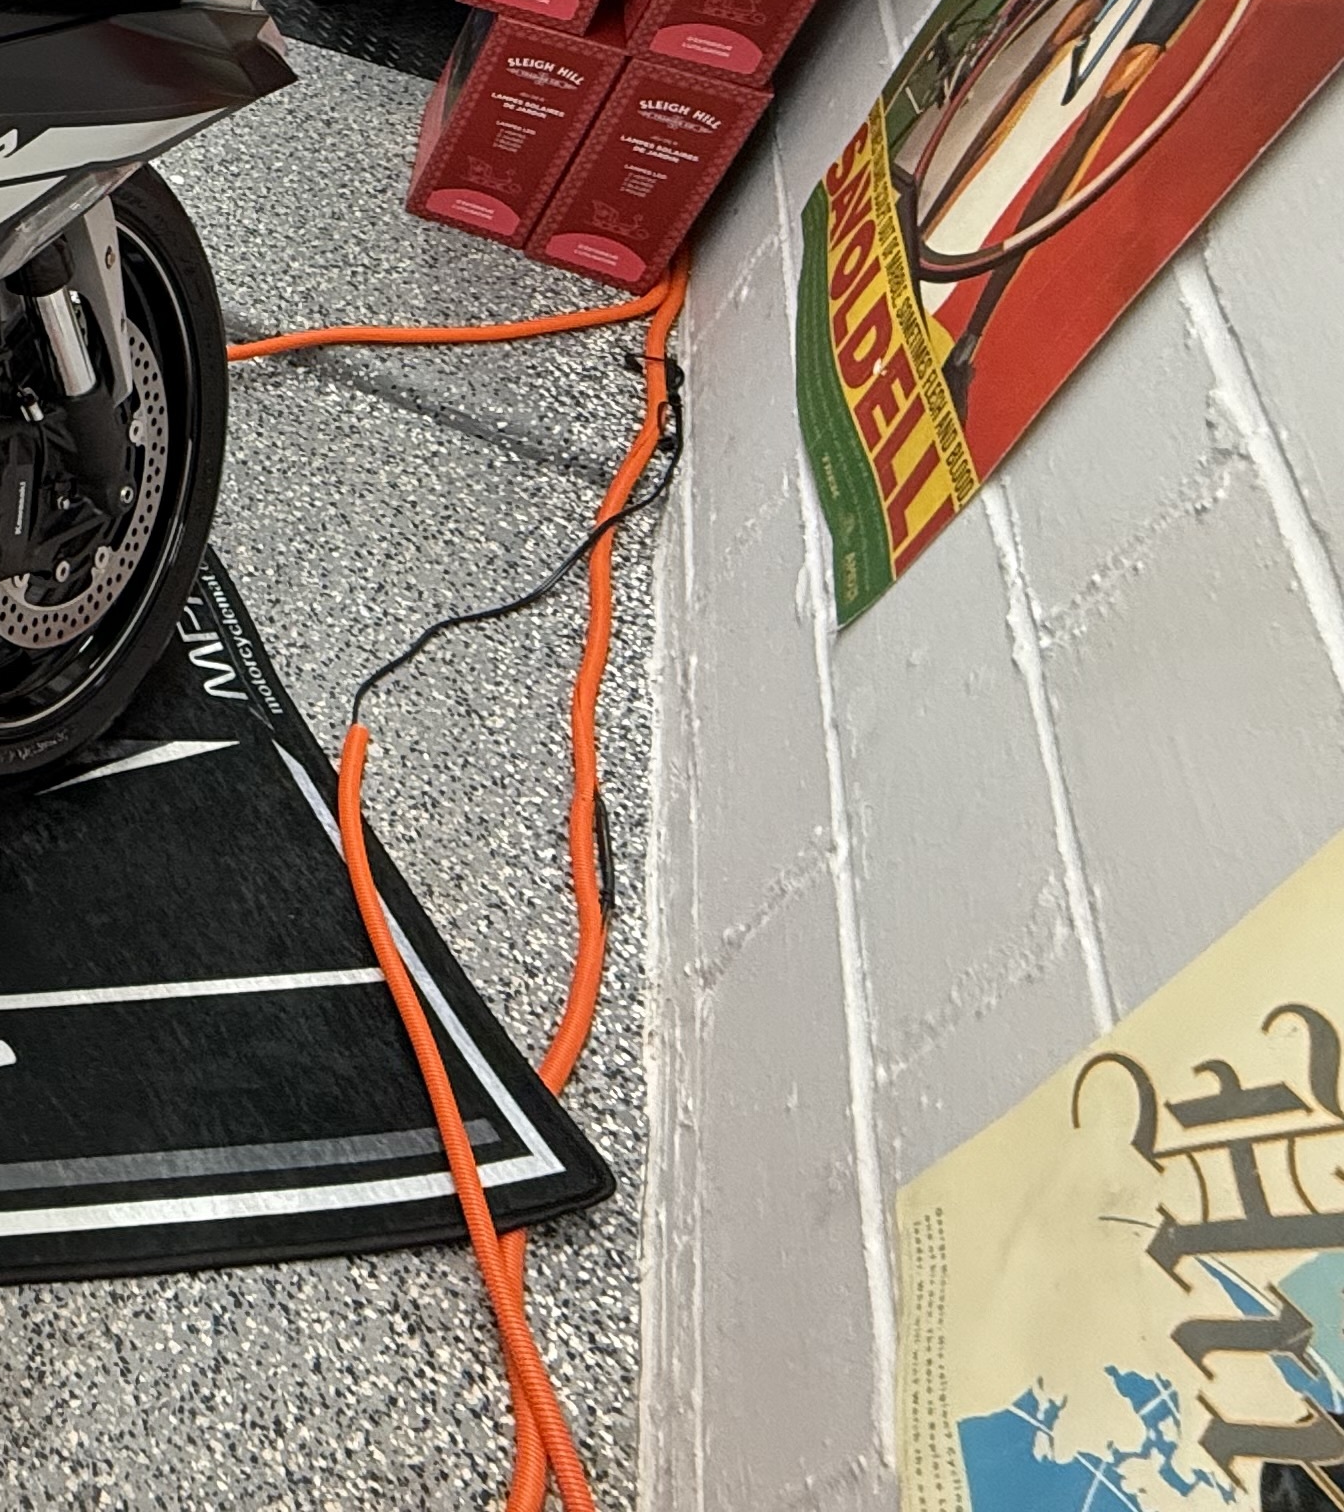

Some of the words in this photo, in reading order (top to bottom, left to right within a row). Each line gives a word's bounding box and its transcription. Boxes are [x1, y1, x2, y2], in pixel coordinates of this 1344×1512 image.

[507, 56, 556, 74] SLEIGH
[557, 66, 585, 87] HILL
[639, 99, 690, 117] SLEIGH
[692, 109, 723, 131] HILL
[825, 122, 958, 582] SAVOLDELLI
[934, 407, 958, 453] AND
